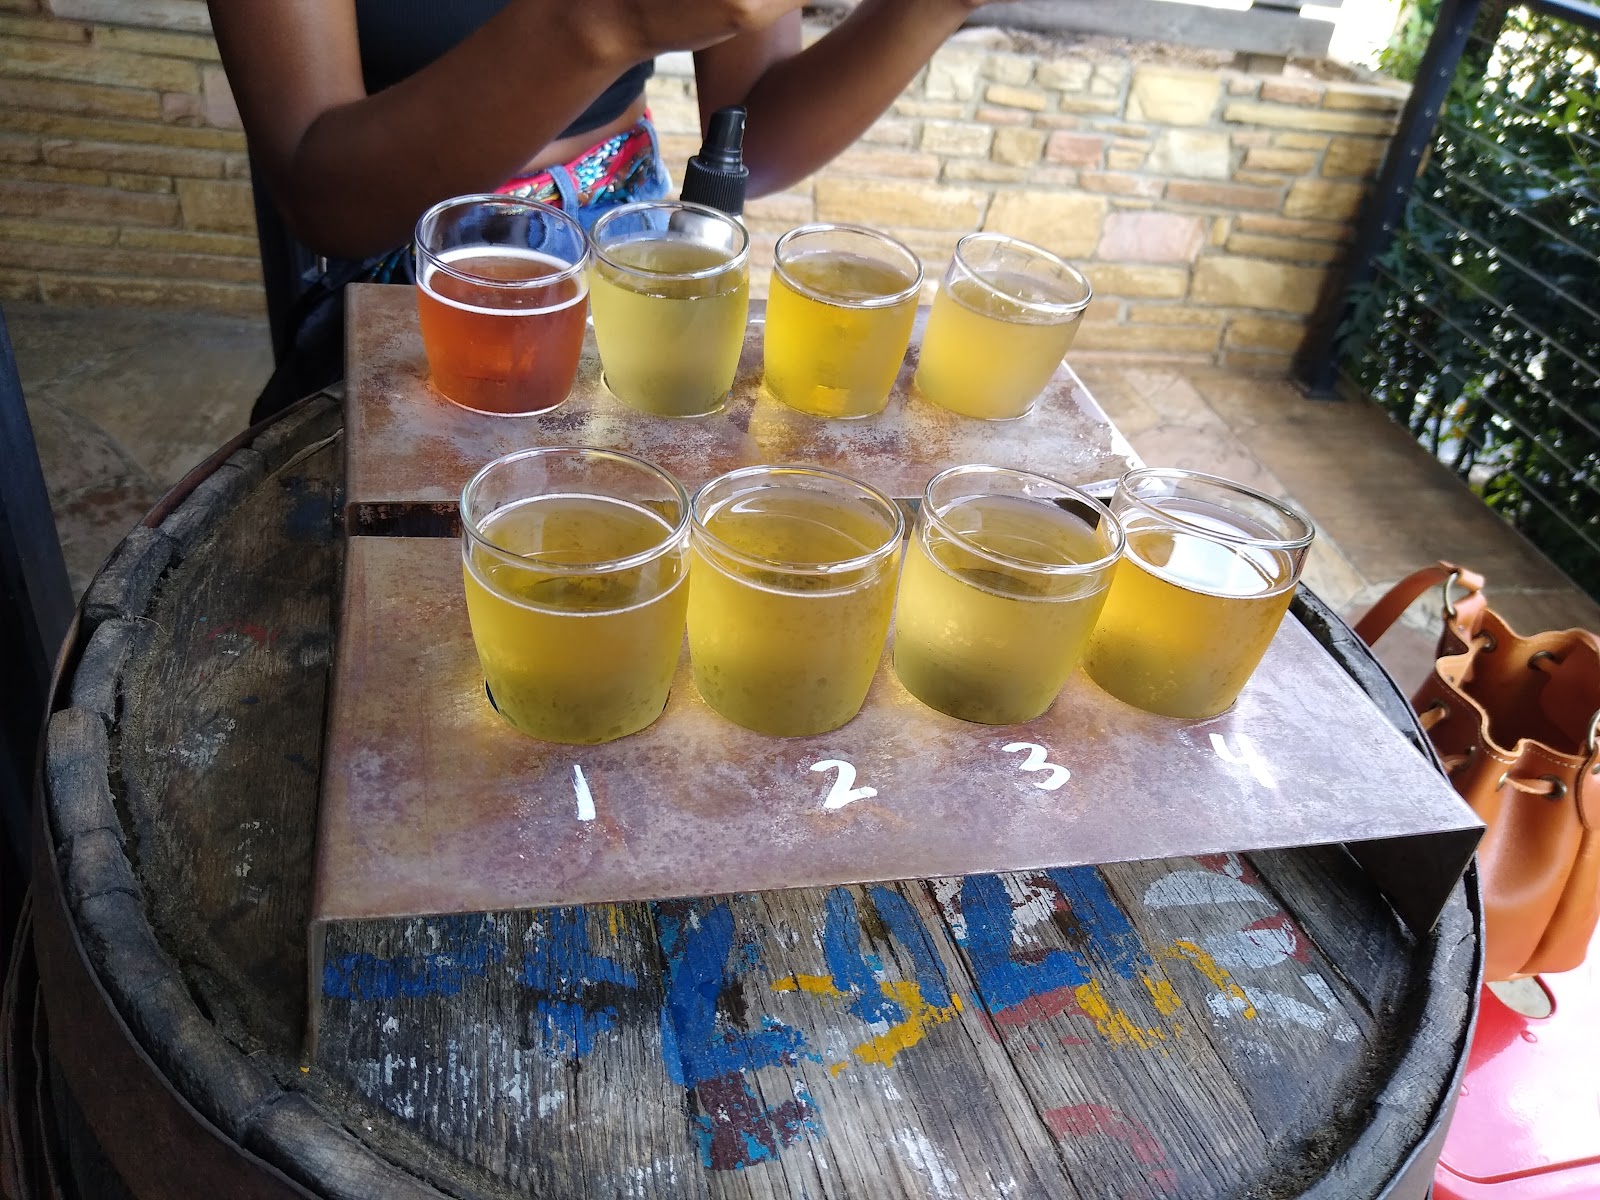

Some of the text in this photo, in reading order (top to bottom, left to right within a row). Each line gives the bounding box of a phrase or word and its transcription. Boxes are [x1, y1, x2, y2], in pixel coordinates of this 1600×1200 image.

[571, 733, 1278, 821] 1 2 3 4
